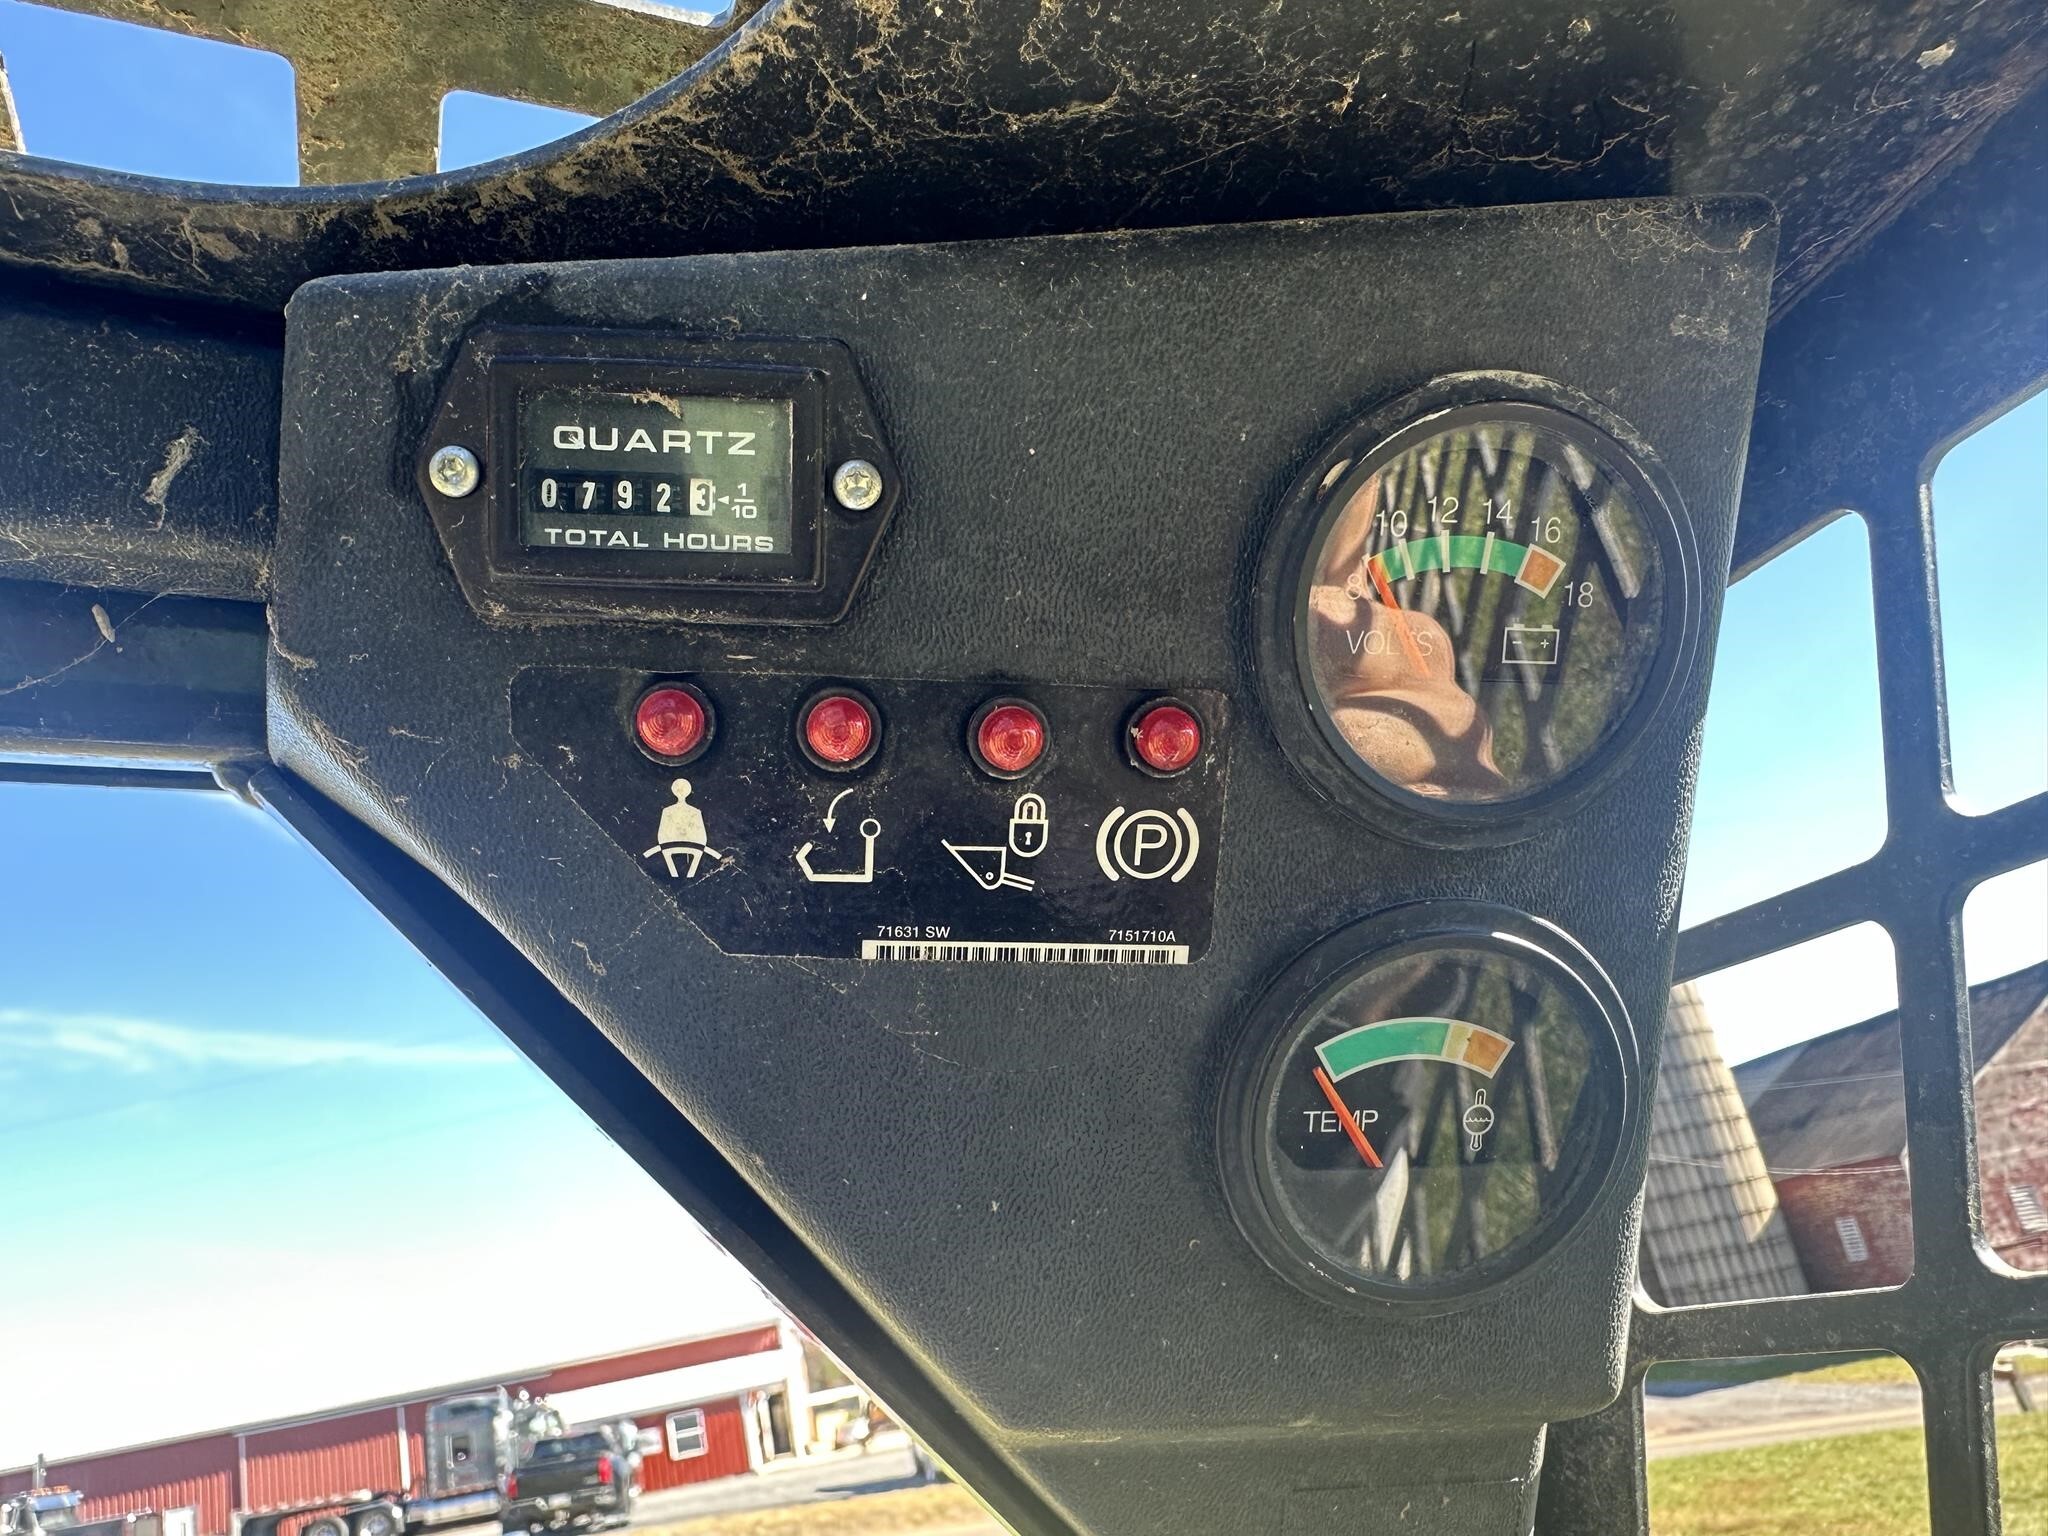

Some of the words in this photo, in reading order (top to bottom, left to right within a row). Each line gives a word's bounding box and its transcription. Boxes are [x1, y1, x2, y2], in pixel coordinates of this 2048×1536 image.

[553, 425, 756, 455] QUARTZ
[544, 528, 649, 548] TOTAL
[663, 532, 774, 552] HOURS
[1376, 510, 1408, 537] 10
[1428, 497, 1459, 523] 12
[1483, 498, 1513, 525] 14
[1531, 517, 1561, 543] 16
[1564, 581, 1593, 608] 18
[1346, 630, 1433, 657] VOLS
[877, 926, 919, 938] 71631
[925, 926, 950, 938] SW
[1108, 929, 1176, 942] 7151710A
